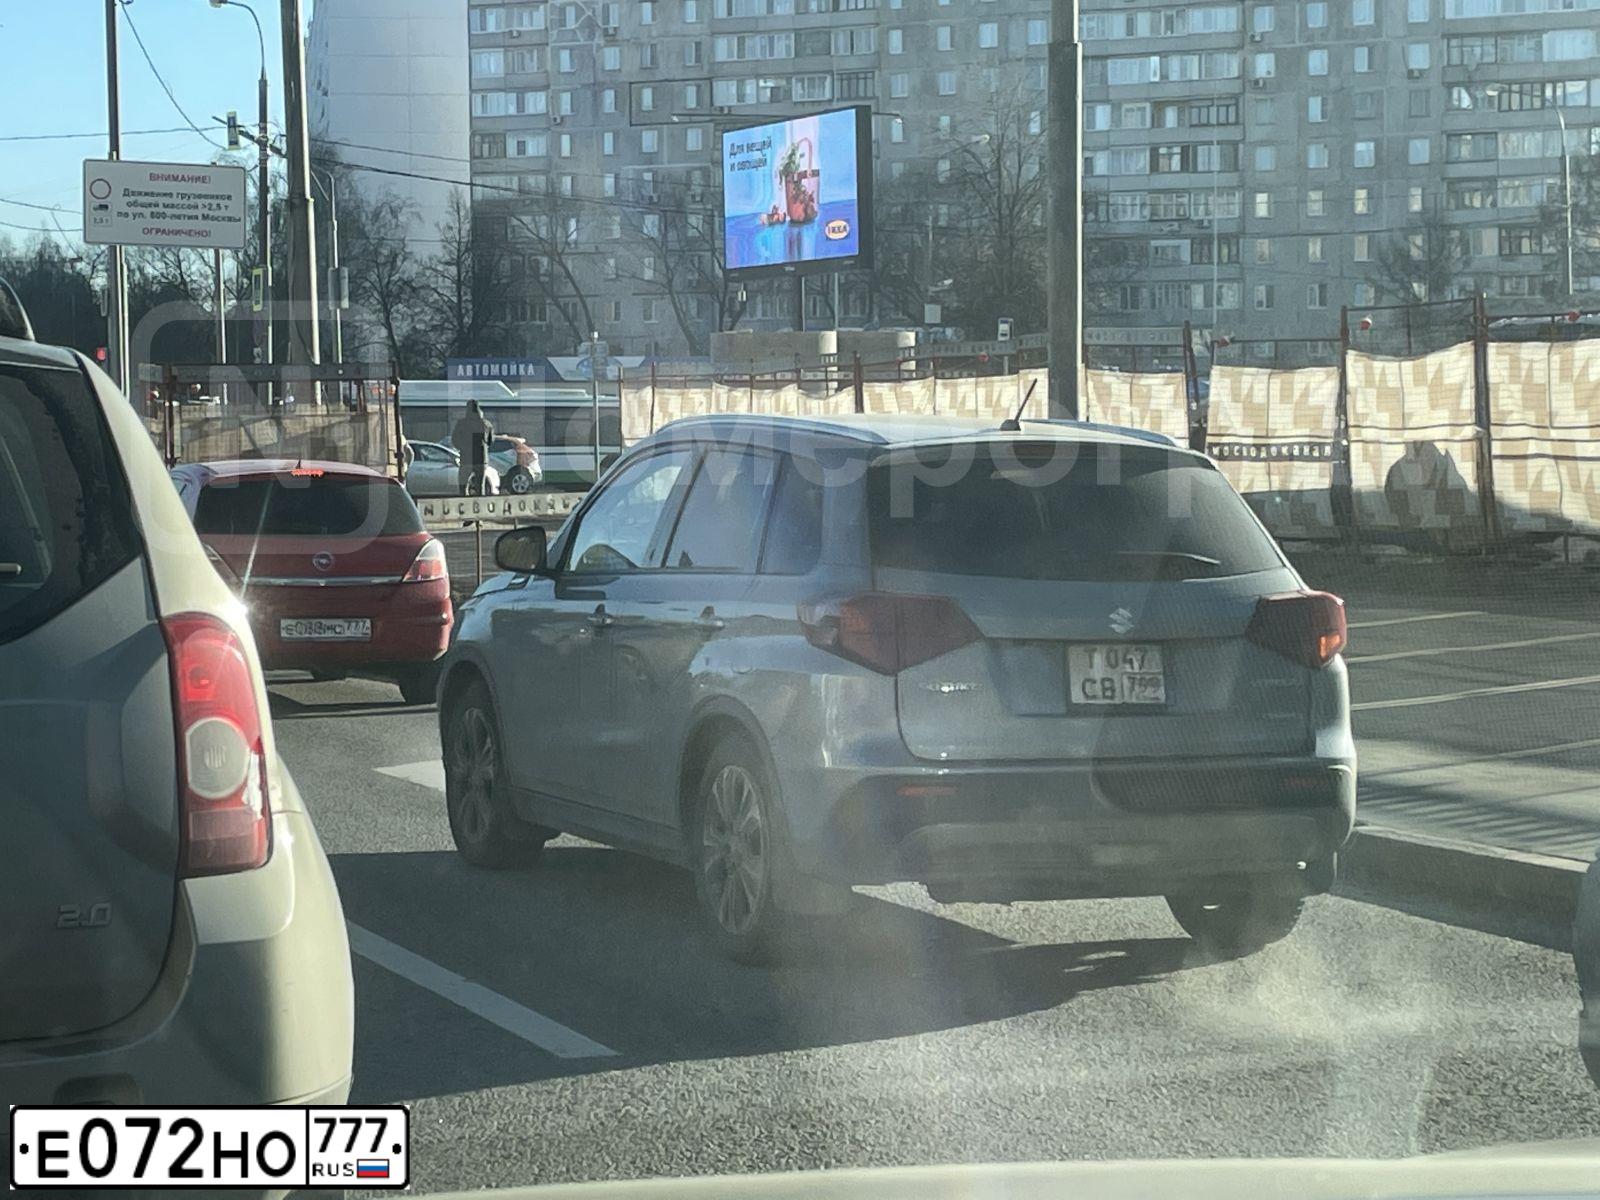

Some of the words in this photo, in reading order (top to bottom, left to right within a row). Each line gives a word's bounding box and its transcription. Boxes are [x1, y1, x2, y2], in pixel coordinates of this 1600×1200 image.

[729, 143, 744, 158] Для
[149, 172, 211, 184] ВНИМАНИЕ!
[122, 187, 173, 199] Движение
[126, 199, 160, 209] общей
[162, 202, 199, 211] массой
[117, 211, 130, 219] по
[201, 213, 242, 222] Москвы
[142, 226, 212, 238] ОГРАНИЧЕНО!
[457, 363, 536, 377] АВТОМОЙКА
[1081, 677, 1115, 700] СВ
